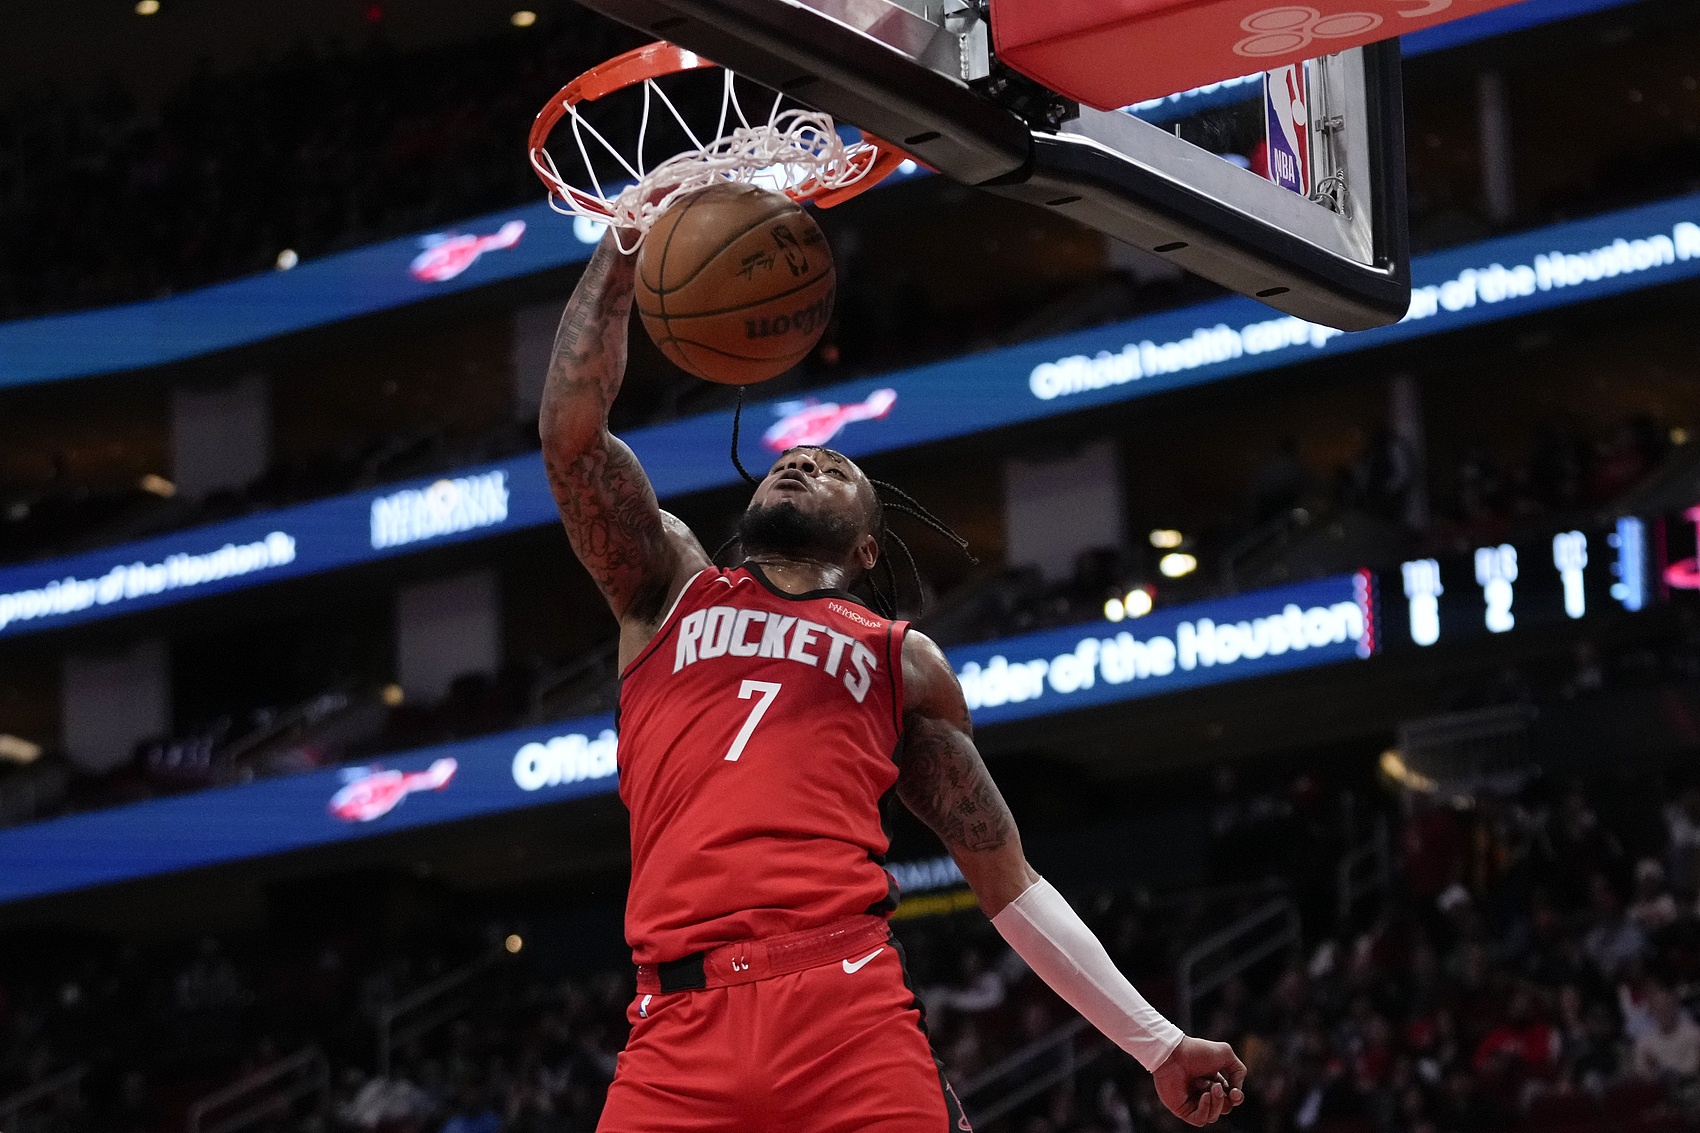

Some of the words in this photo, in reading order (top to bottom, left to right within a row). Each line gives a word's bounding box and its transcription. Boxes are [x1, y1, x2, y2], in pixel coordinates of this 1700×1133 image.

[1274, 147, 1296, 184] NBA
[1030, 343, 1142, 399] Official
[1140, 324, 1243, 376] health
[1242, 316, 1311, 354] care
[1439, 268, 1477, 311] of
[1479, 263, 1536, 302] the
[1535, 234, 1675, 290] Houston
[95, 565, 127, 605] of
[123, 561, 162, 598] the
[163, 543, 269, 589] Houston
[672, 605, 878, 704] ROCKETS
[1048, 638, 1101, 693] of
[1100, 632, 1176, 684] the
[1177, 602, 1364, 671] Houston
[512, 729, 617, 791] Offici
[724, 680, 782, 762] 7
